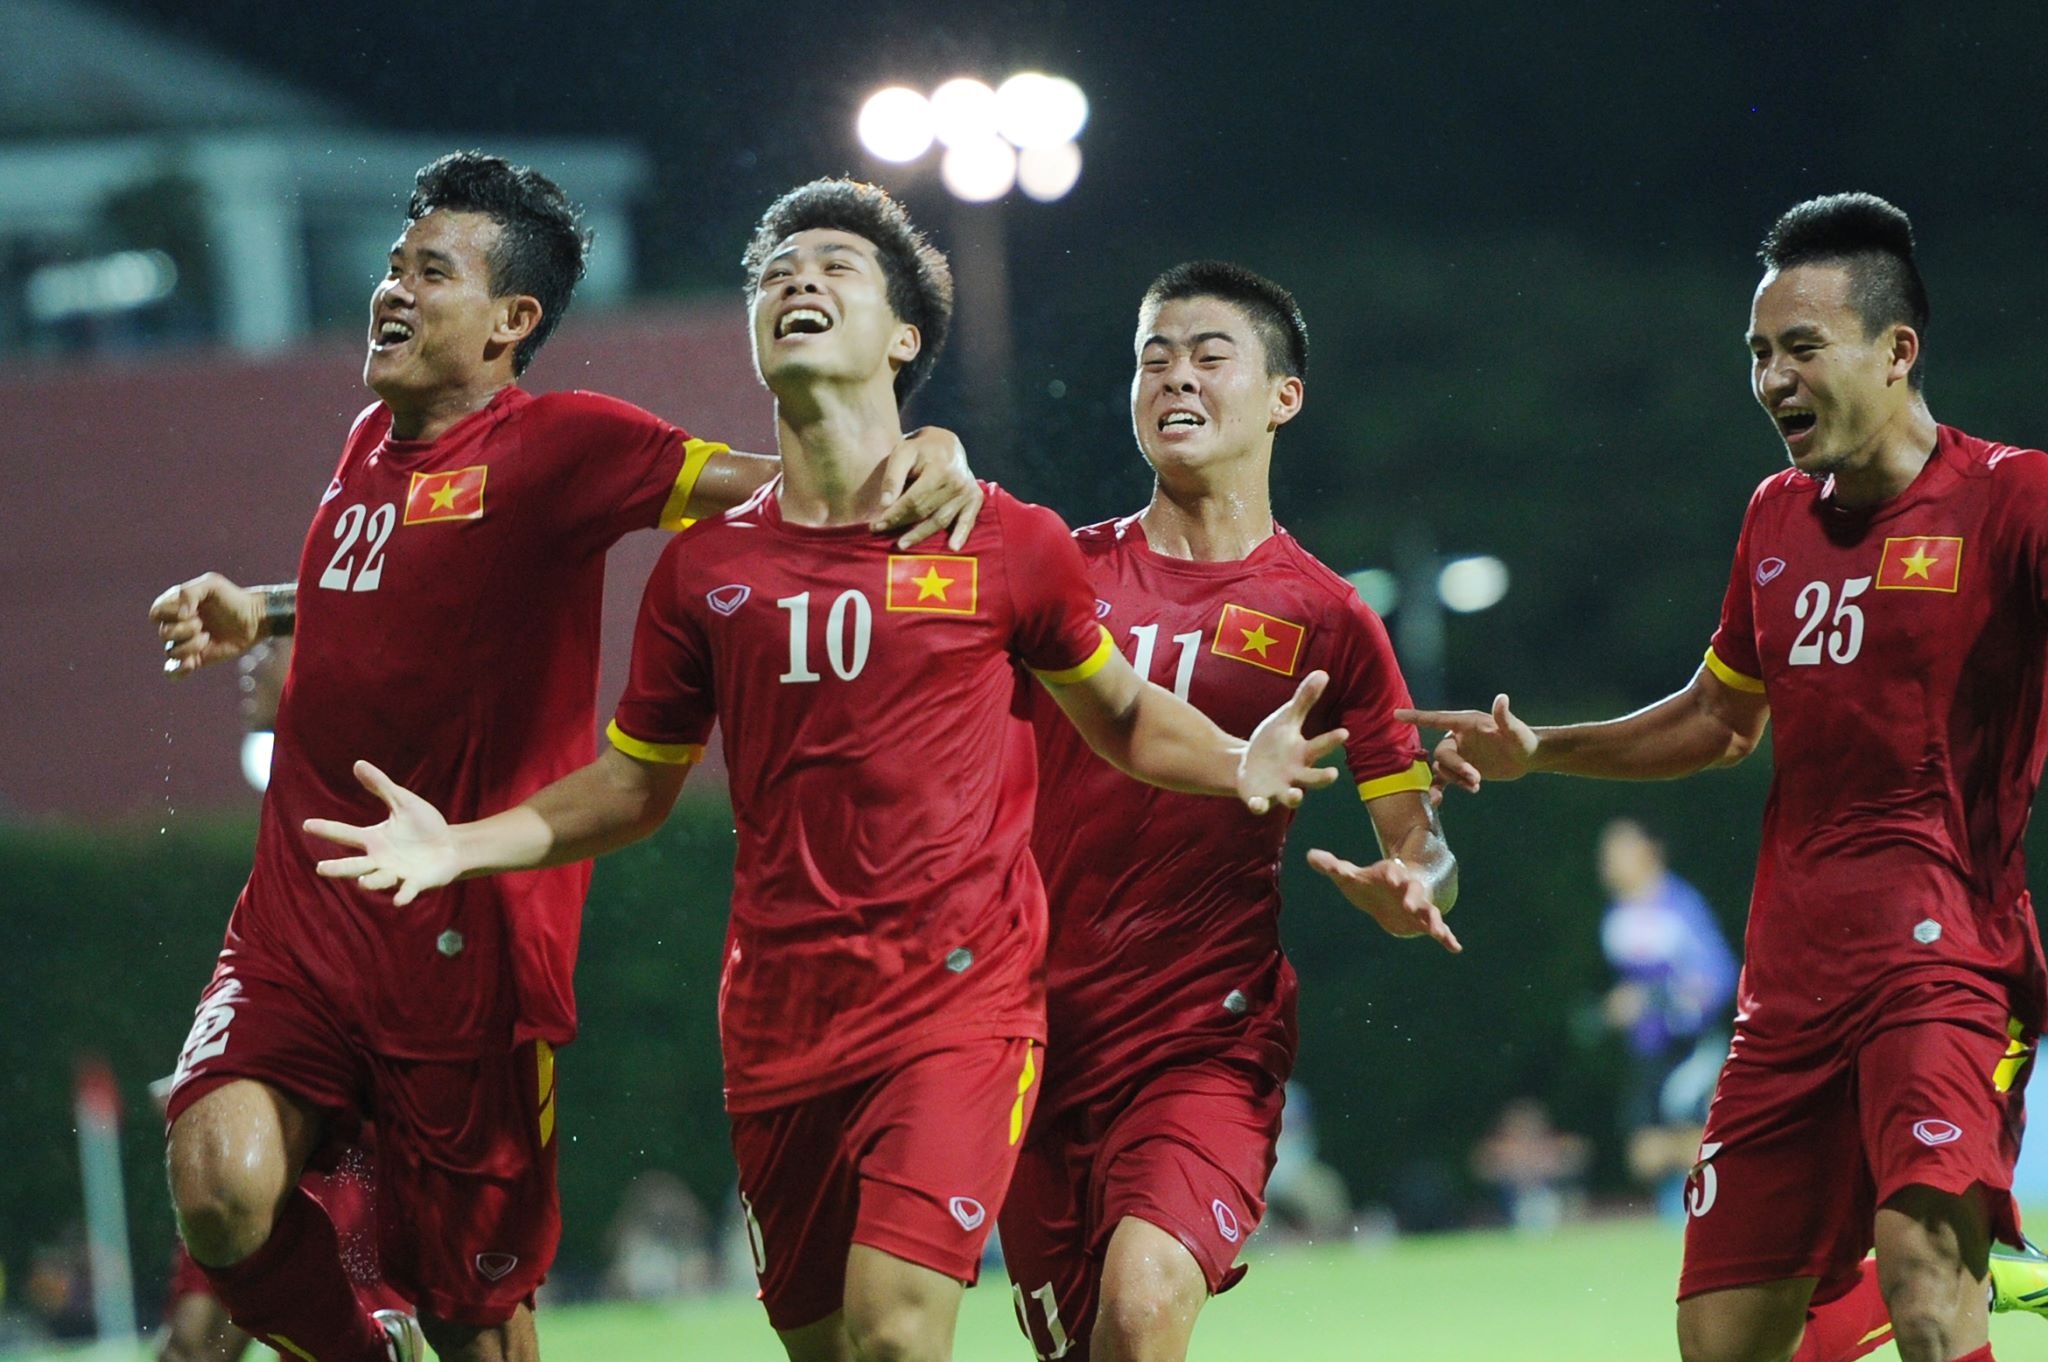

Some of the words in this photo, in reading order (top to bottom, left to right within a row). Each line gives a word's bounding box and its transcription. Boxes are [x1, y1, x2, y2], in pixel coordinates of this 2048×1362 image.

[319, 503, 396, 592] 22
[777, 589, 872, 683] 10
[1129, 623, 1202, 704] 11
[1789, 576, 1872, 666] 25
[1688, 1142, 1723, 1217] 5
